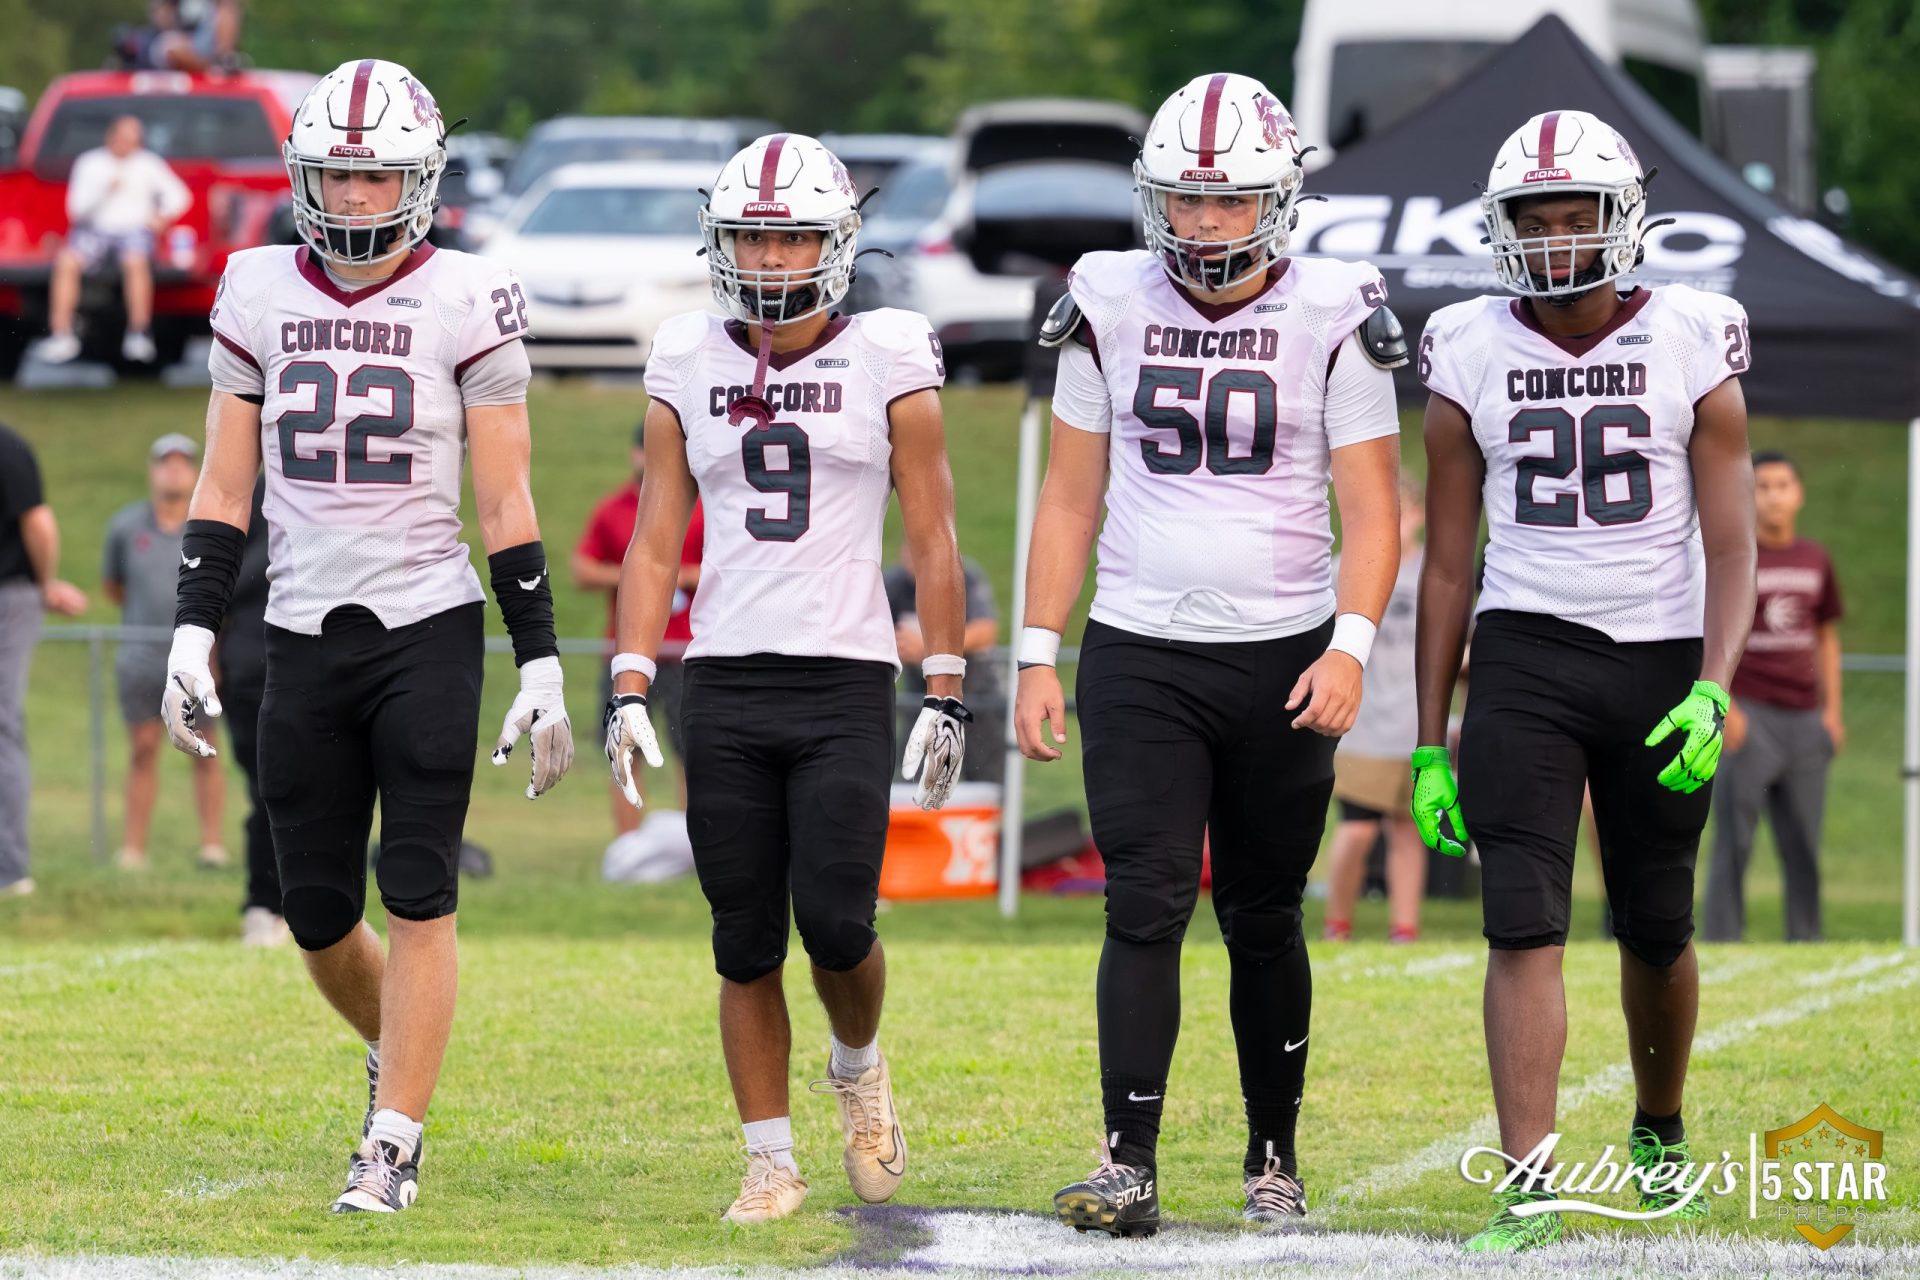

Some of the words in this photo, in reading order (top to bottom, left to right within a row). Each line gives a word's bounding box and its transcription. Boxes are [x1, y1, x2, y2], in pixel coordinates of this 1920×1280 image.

[332, 146, 372, 157] LIONS
[1183, 171, 1224, 180] LIONS
[1526, 169, 1567, 181] LIONS
[746, 203, 787, 212] LIONS
[389, 298, 419, 307] BATTLE
[491, 283, 529, 336] 22
[281, 319, 413, 357] CONCORD
[1144, 324, 1278, 361] CONCORD
[1507, 363, 1647, 401] CONCORD
[276, 361, 414, 484] 22
[1133, 365, 1278, 476] 50
[742, 422, 810, 542] 9
[1508, 404, 1653, 528] 26
